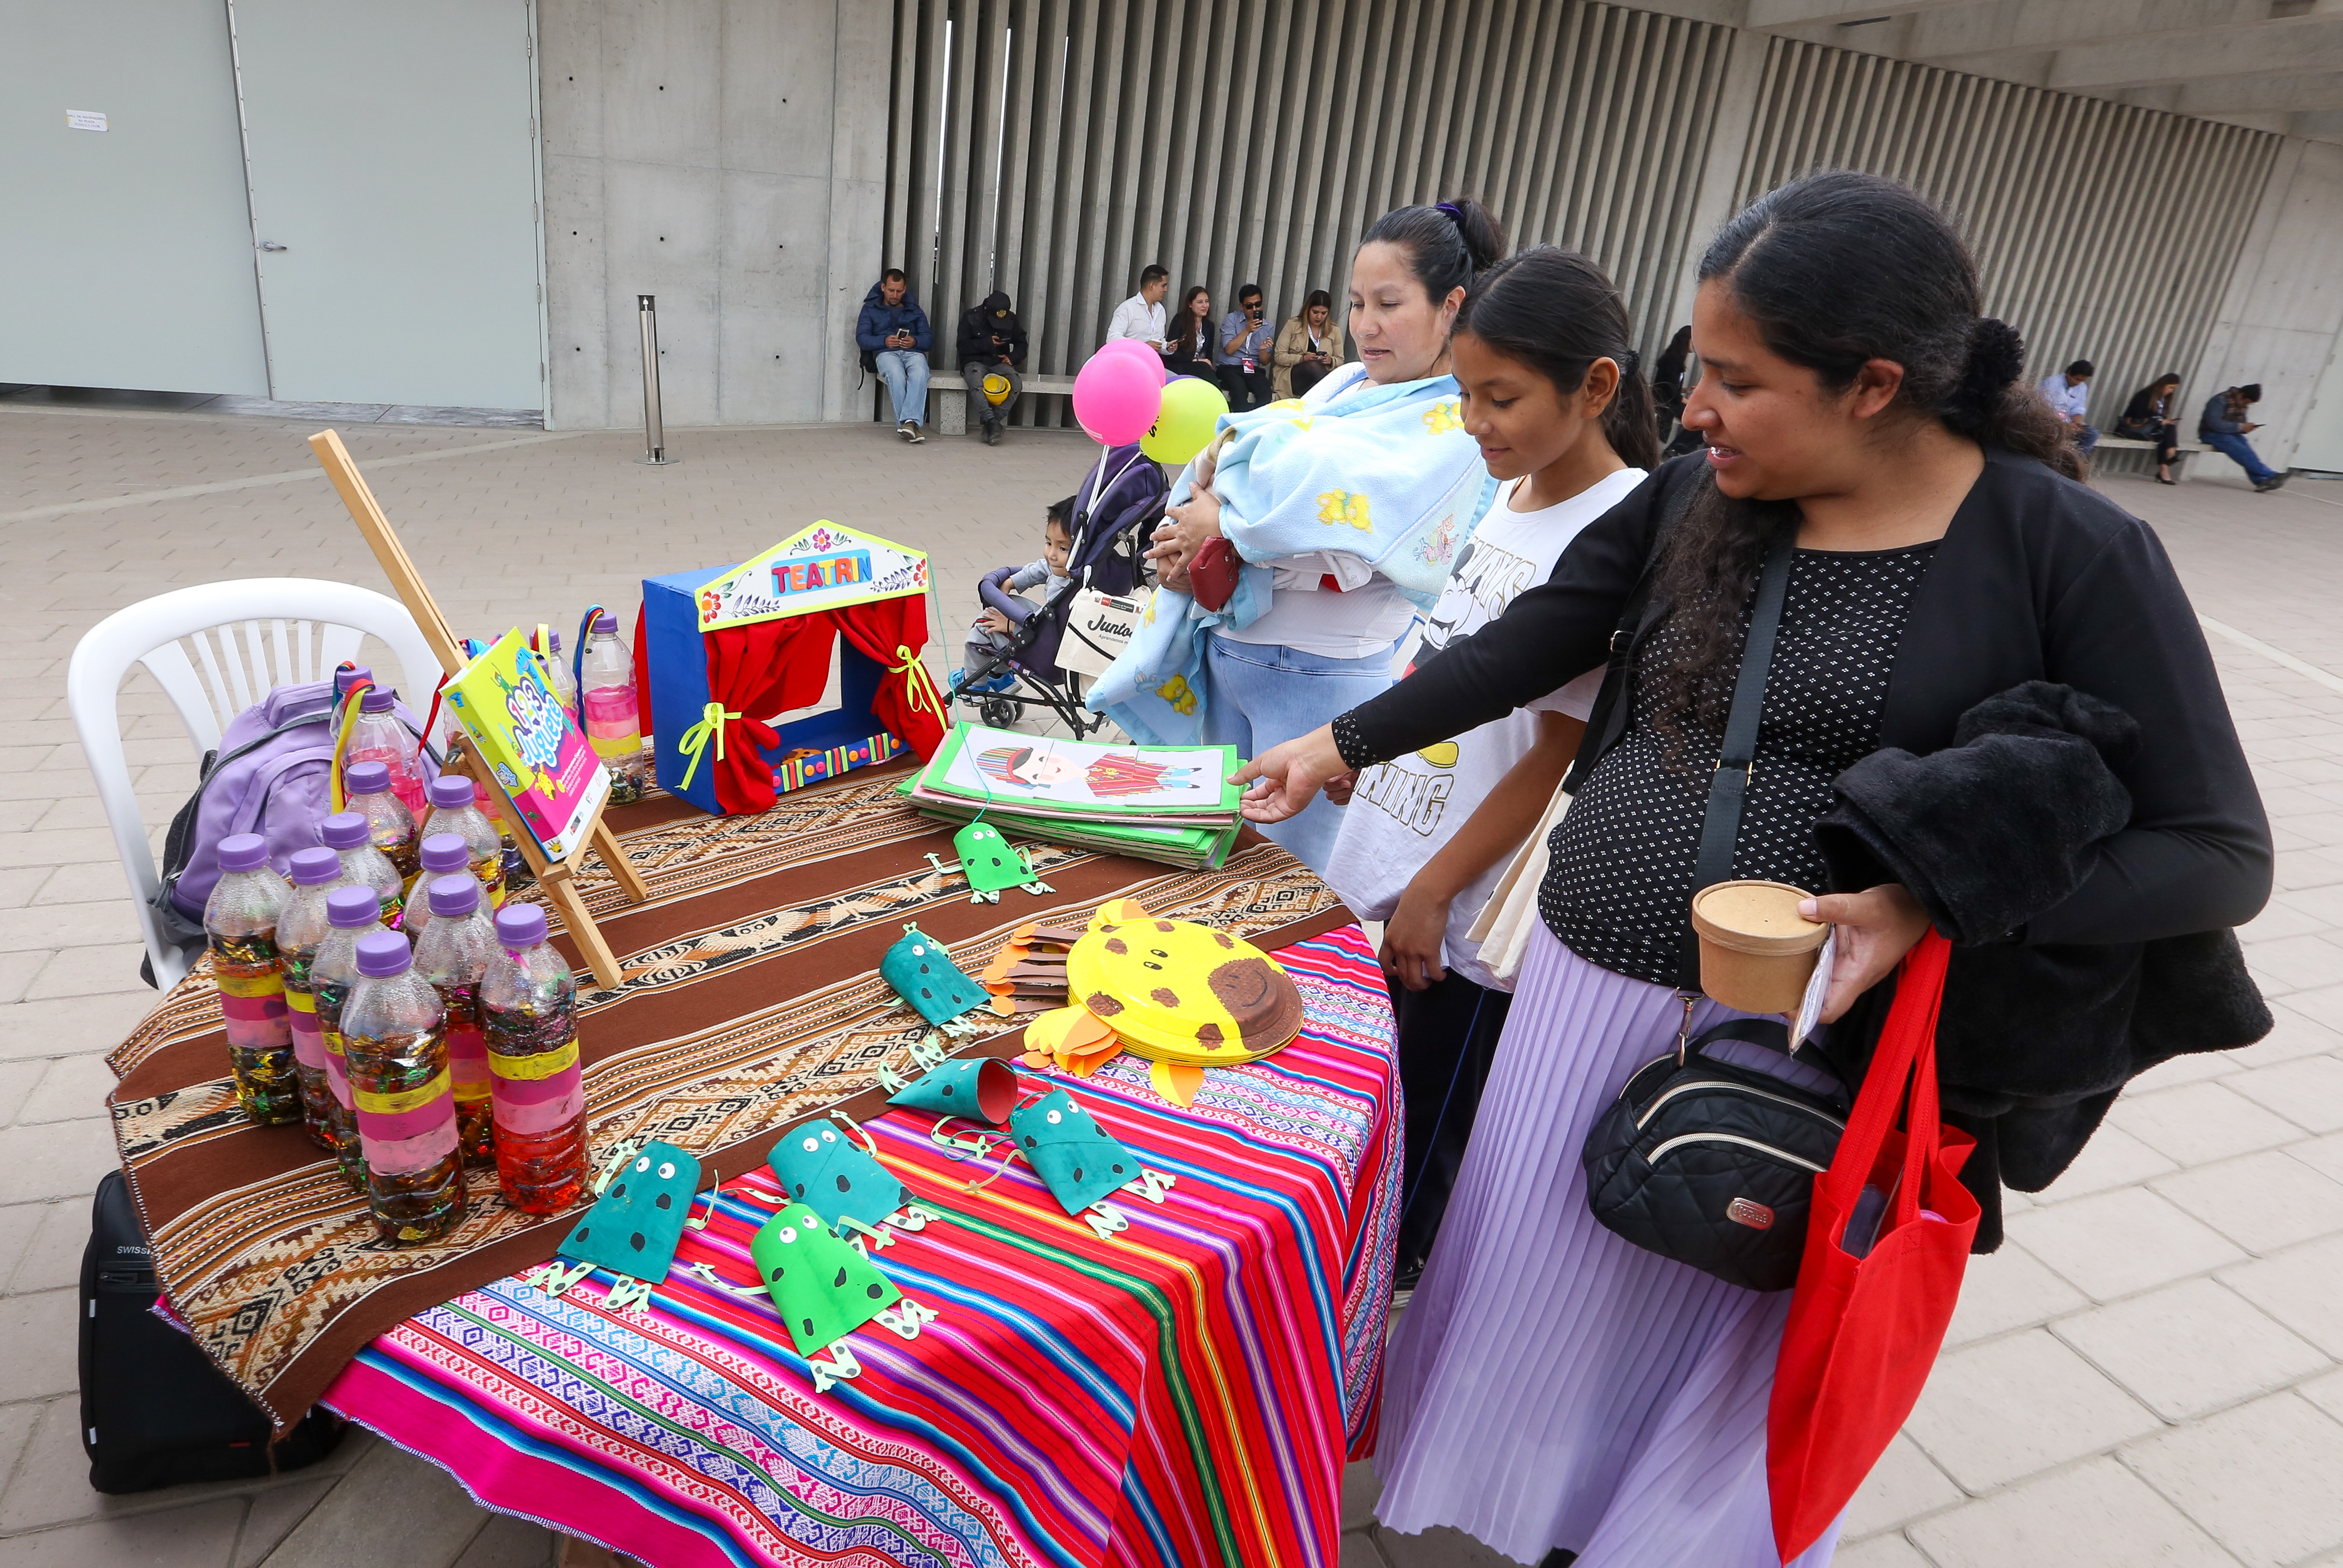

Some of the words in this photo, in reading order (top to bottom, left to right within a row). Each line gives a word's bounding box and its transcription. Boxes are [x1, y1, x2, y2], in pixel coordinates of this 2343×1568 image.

[772, 556, 873, 593] TEATRIN
[1098, 634, 1124, 644] Aprendemos
[516, 695, 563, 767] Juguete
